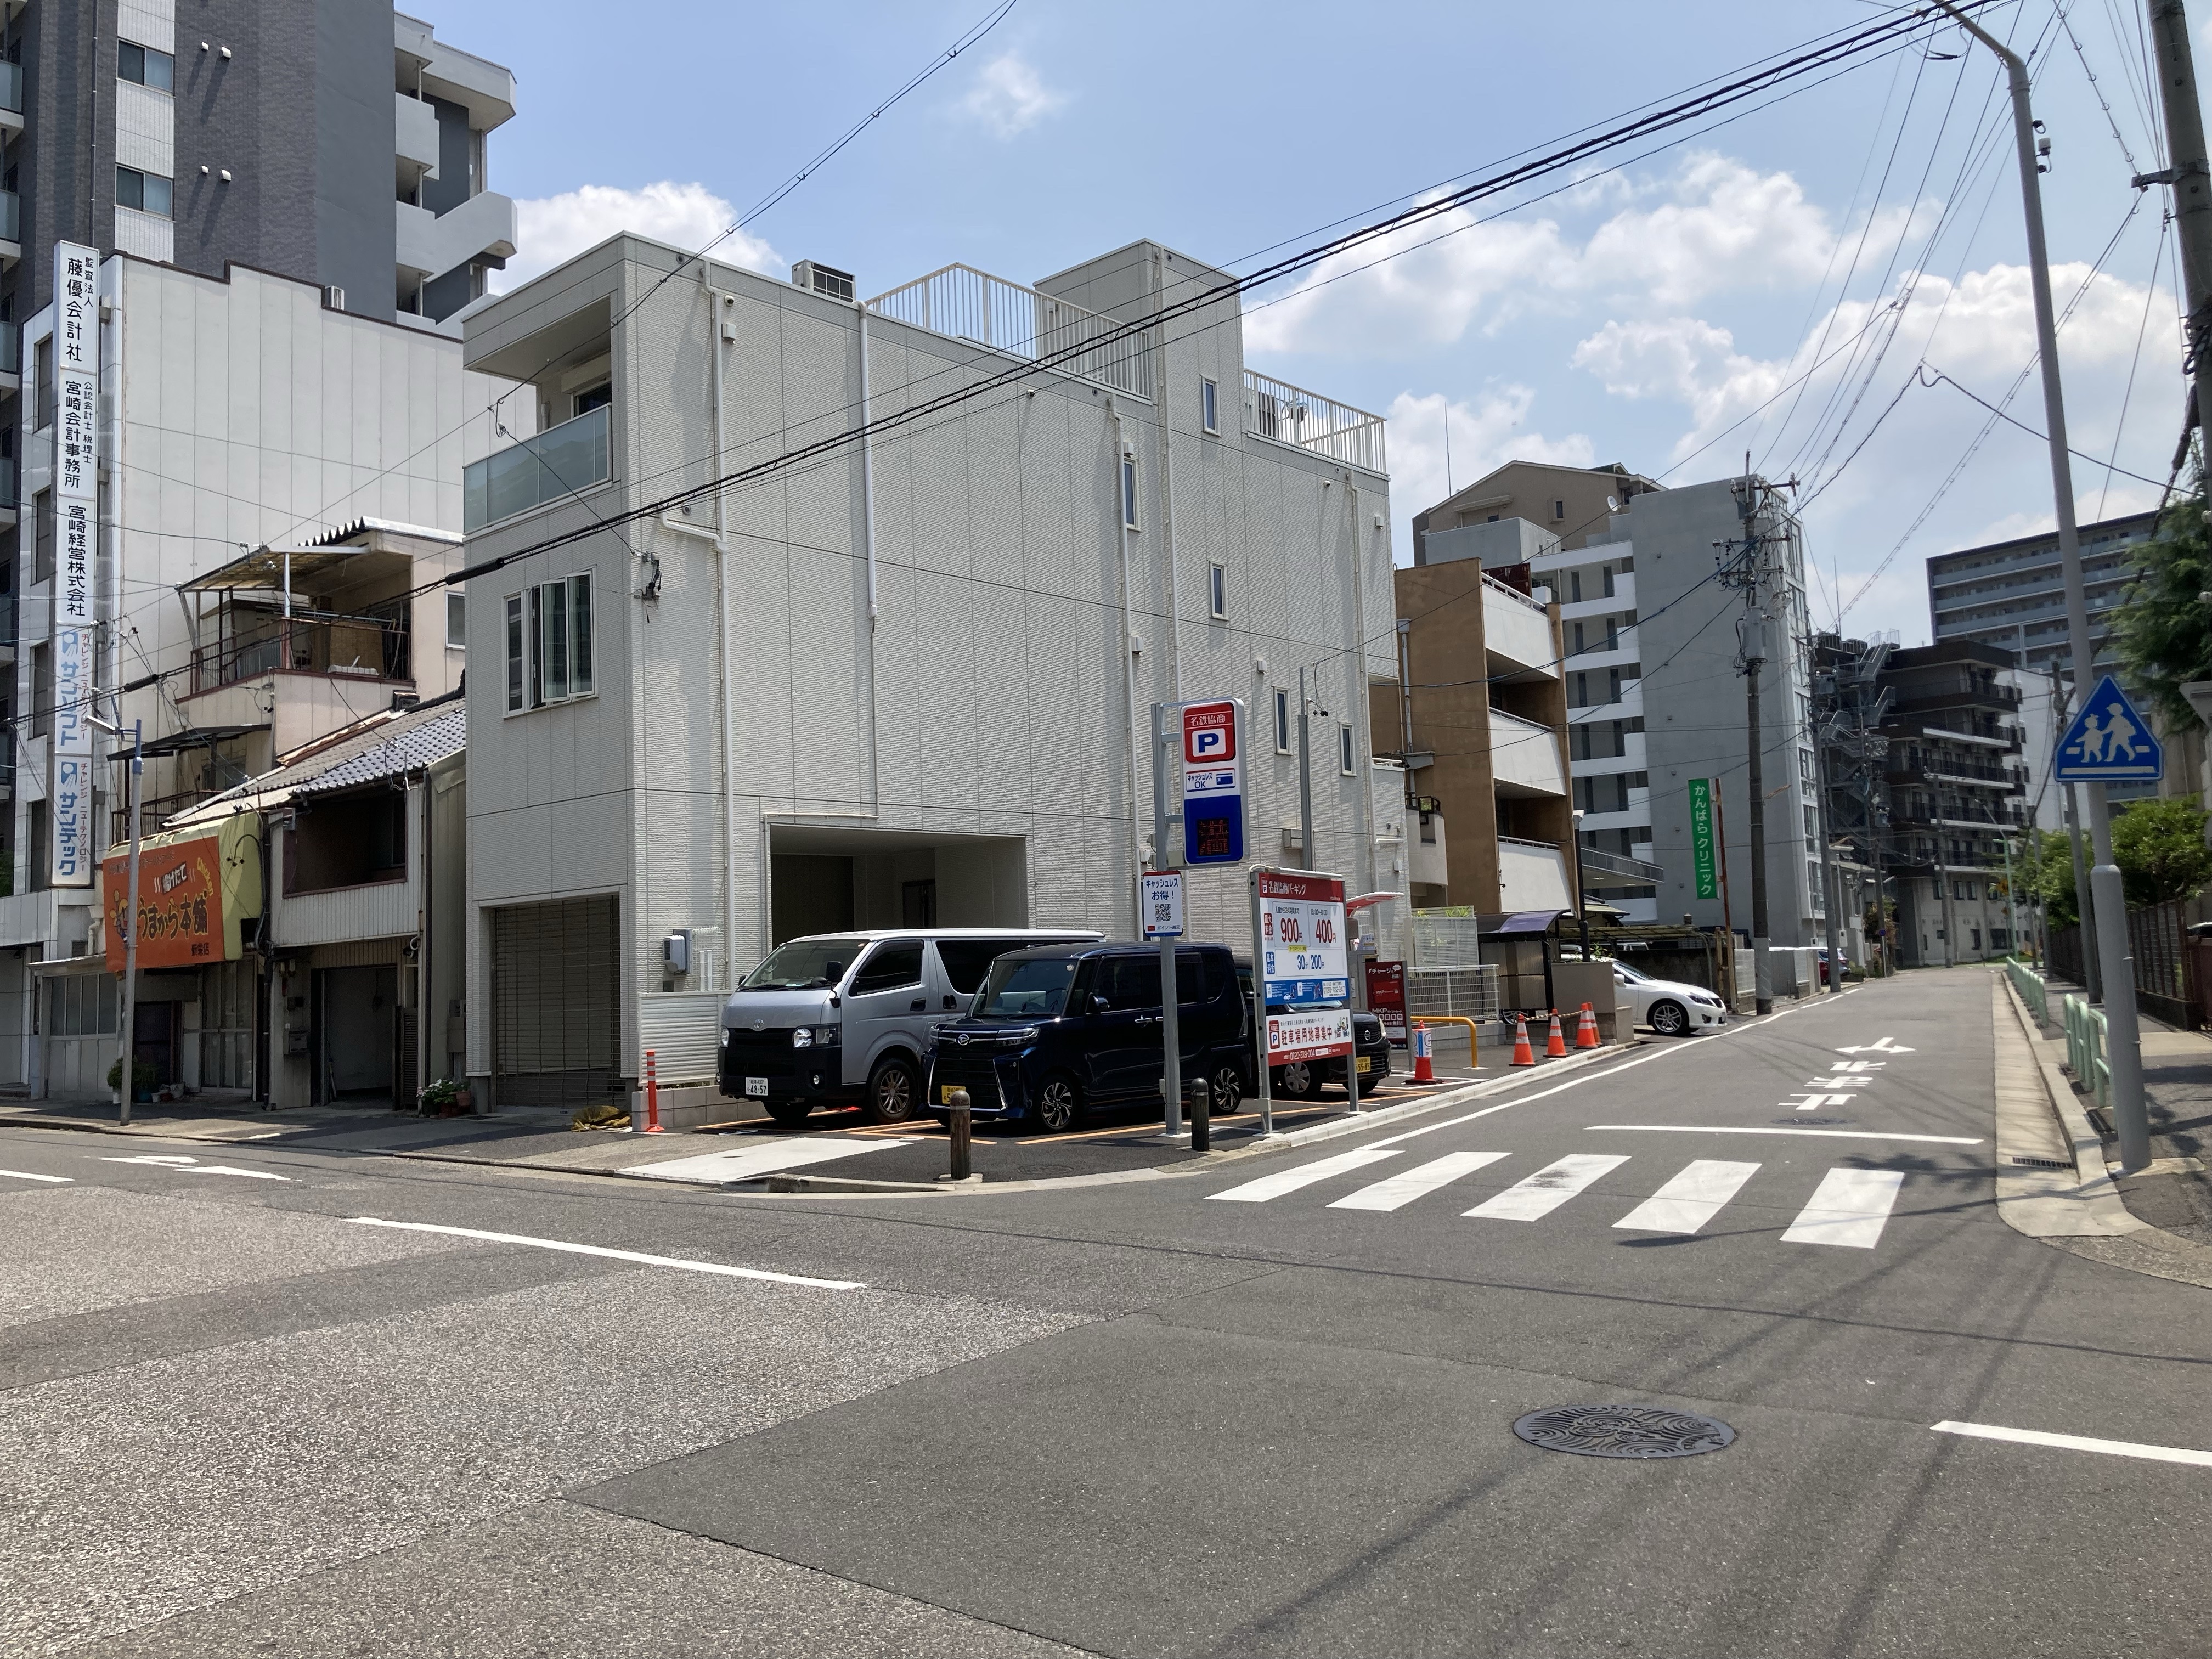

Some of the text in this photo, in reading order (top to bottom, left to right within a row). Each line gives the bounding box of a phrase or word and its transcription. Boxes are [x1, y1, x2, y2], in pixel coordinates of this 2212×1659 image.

[84, 256, 94, 308] 監査法人
[66, 257, 83, 362] 藤優会計社
[83, 381, 93, 464] 公認会計士 税理士
[65, 380, 81, 489] 宮崎会計事務所
[67, 505, 87, 617] 宮崎経営株式会社
[60, 661, 79, 747] サンソフト
[1190, 714, 1226, 726] 名鉄協商
[1198, 733, 1219, 753] P
[1188, 772, 1213, 782] キャッシュレス
[1194, 780, 1206, 788] OK
[58, 792, 78, 876] サンテック
[1694, 785, 1712, 895] かんばらクリニック
[1146, 878, 1179, 888] キャッシュレス
[1268, 881, 1307, 895] 名鉄協商パーキング
[1272, 1034, 1277, 1044] P
[1281, 1025, 1333, 1046] 駐車場用地募集中
[751, 1085, 766, 1094] 48-57
